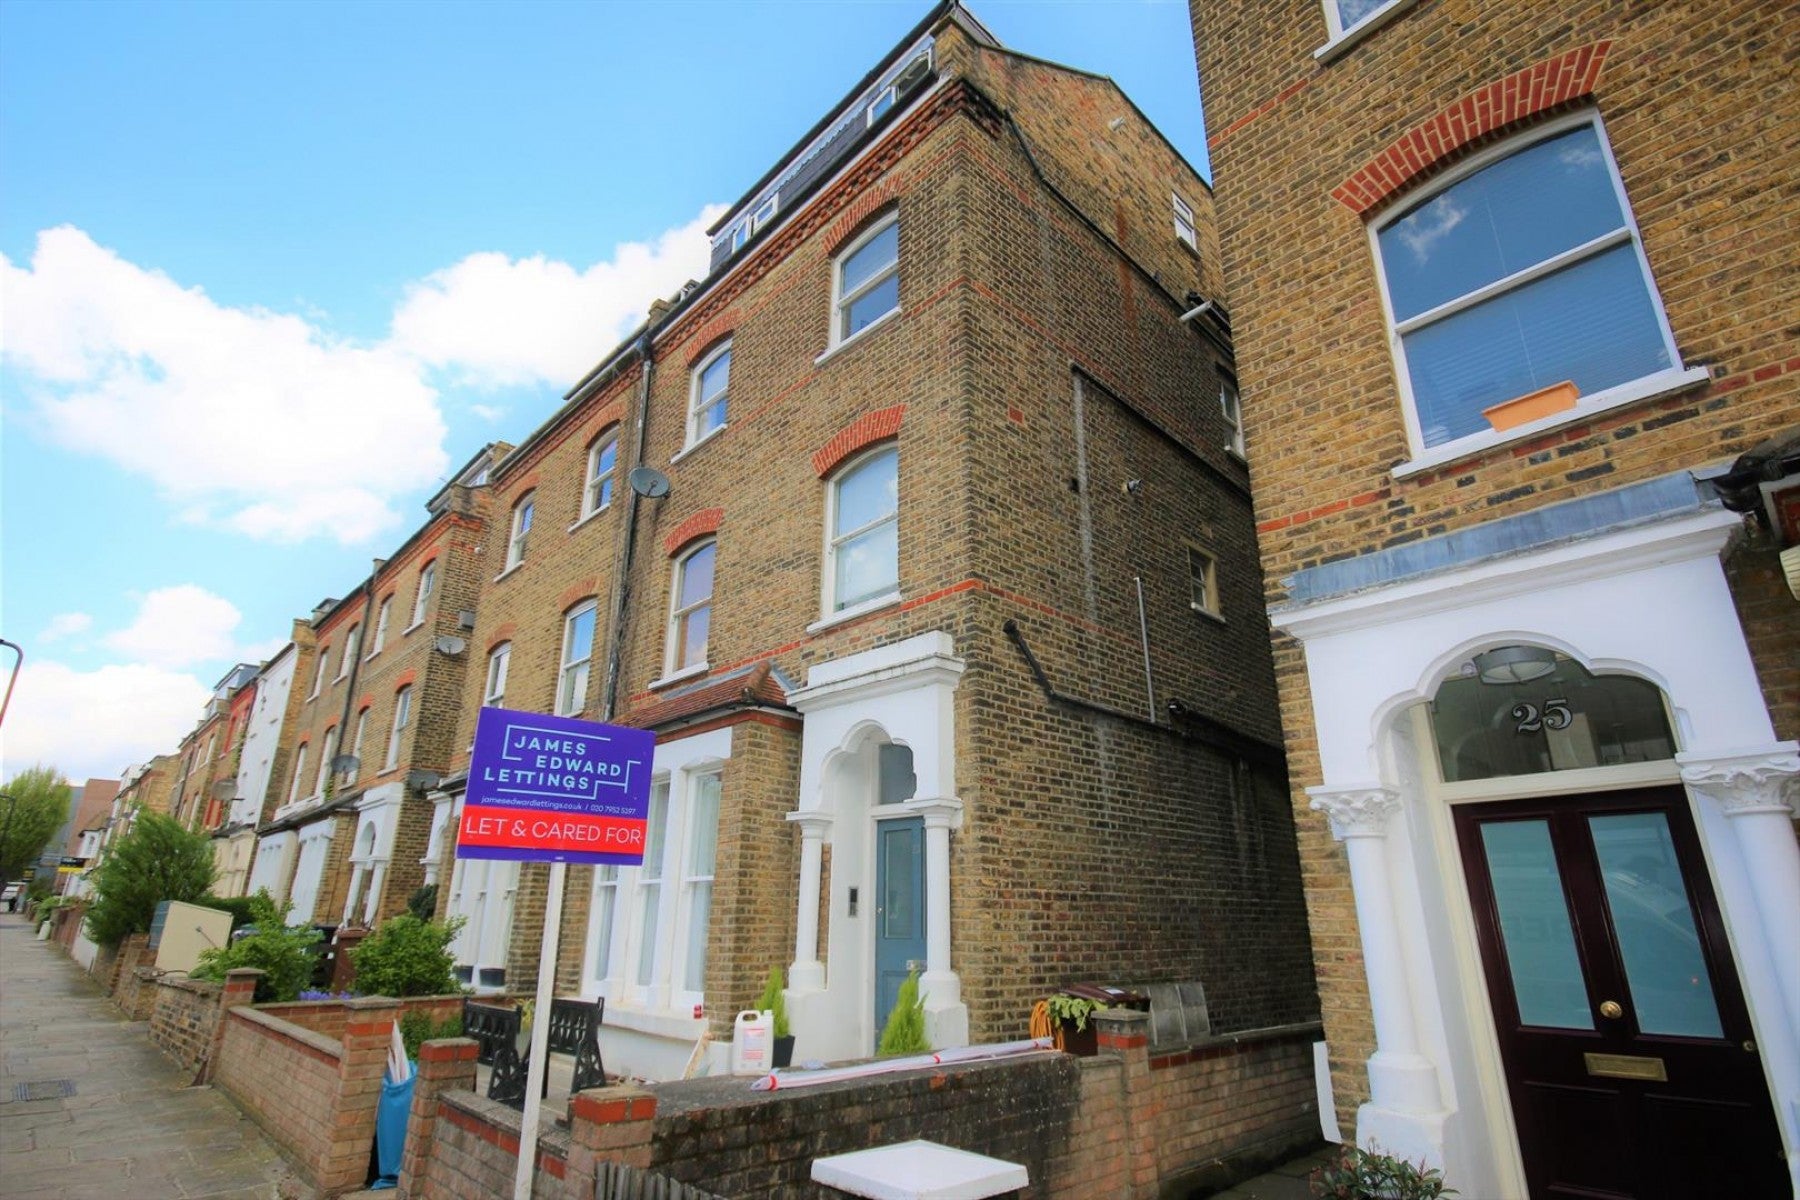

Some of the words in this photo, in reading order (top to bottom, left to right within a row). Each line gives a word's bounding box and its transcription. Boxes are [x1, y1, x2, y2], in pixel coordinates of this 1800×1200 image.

[1511, 698, 1573, 735] 25
[514, 736, 586, 756] JAMES
[536, 755, 621, 777] EDWARD
[484, 767, 589, 791] LETTINGS
[466, 816, 508, 836] LET
[511, 820, 527, 837] &
[532, 821, 600, 842] CARED
[605, 827, 641, 844] FOR
